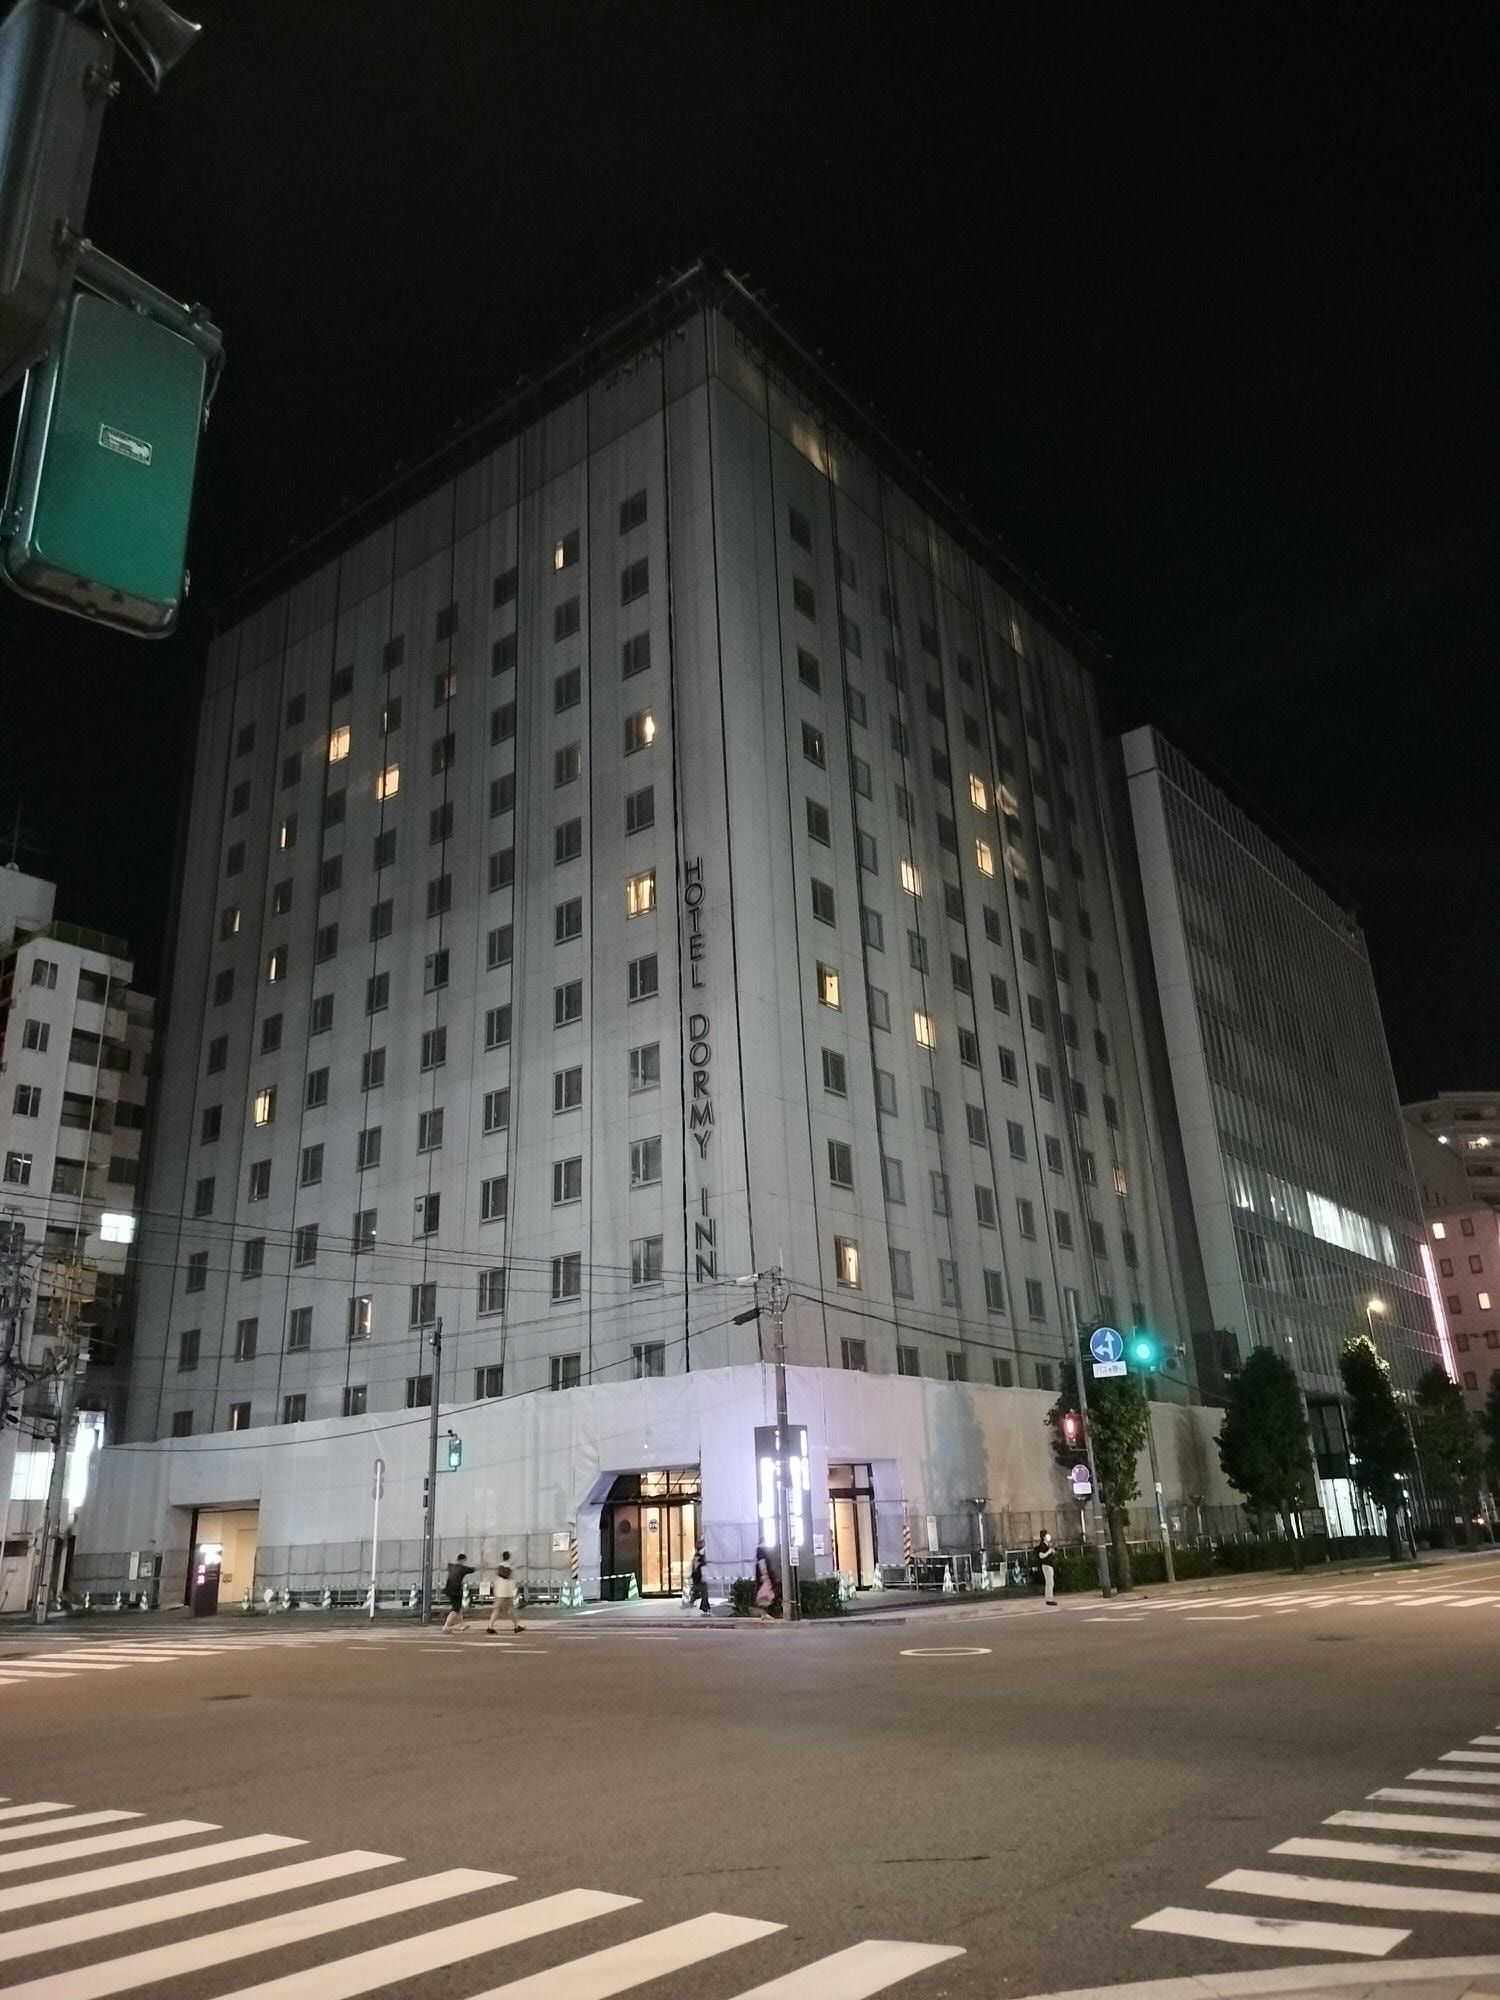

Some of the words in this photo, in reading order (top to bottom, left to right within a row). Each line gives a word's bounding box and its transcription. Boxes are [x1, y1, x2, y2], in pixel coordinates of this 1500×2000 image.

[685, 856, 705, 989] HOTEL
[689, 1014, 714, 1160] DORMY
[695, 1187, 717, 1283] INN
